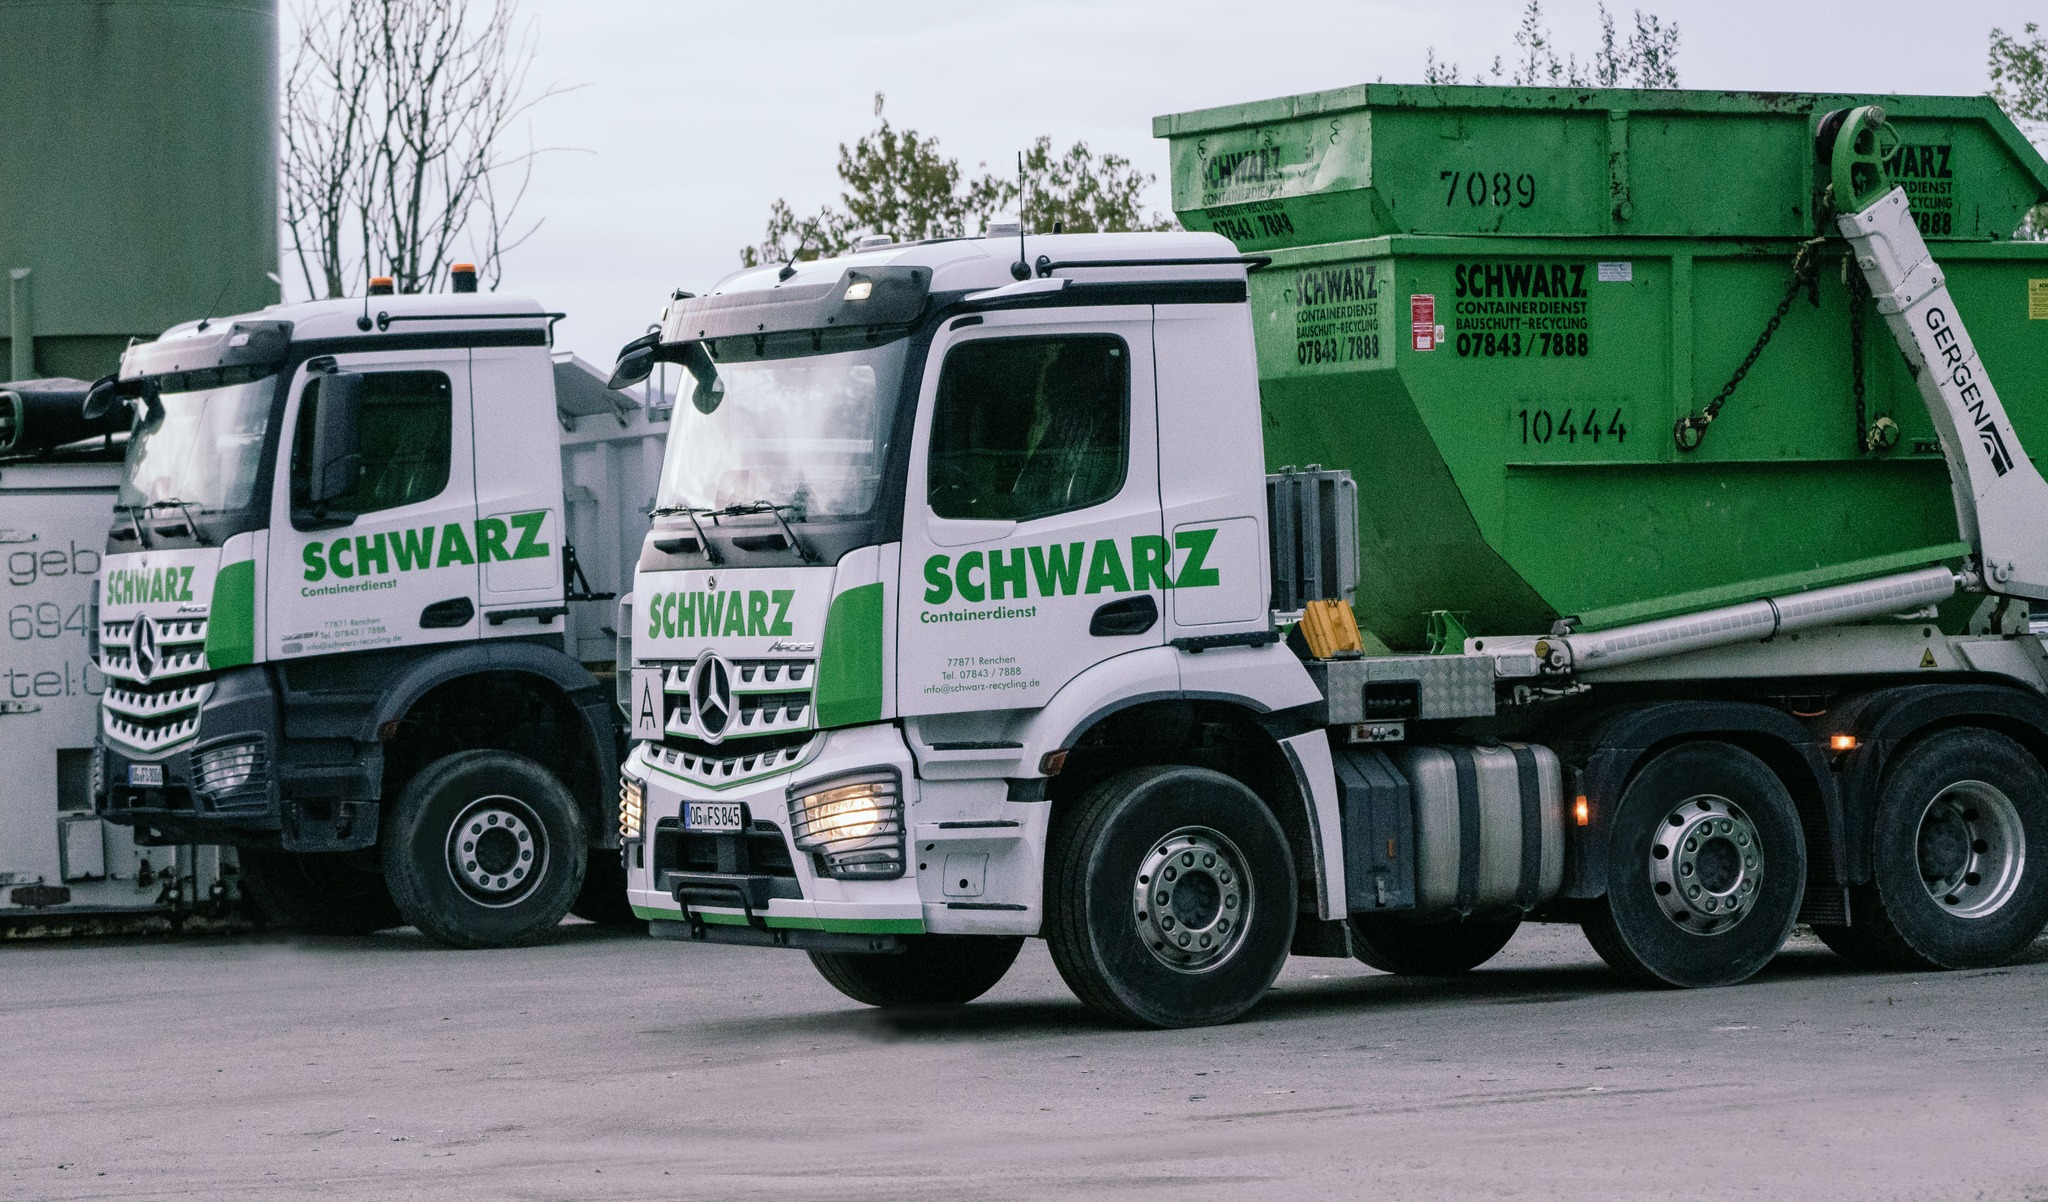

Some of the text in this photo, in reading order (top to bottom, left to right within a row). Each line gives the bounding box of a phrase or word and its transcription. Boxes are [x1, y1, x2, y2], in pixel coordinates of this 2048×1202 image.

[1202, 147, 1282, 190] SCHWARZ
[1440, 171, 1535, 208] 7089
[1258, 212, 1295, 237] 7888
[1296, 265, 1378, 307] SCHWARZ
[1455, 263, 1588, 298] SCHWARZ
[1296, 303, 1378, 323] CONTAINERDIENST
[1456, 301, 1588, 315] CONTAINERDIENST
[1296, 319, 1379, 339] BAUSCHUTT-RECYCLING
[1456, 317, 1588, 330] BAUSCHUTT-RECYCLING
[1298, 338, 1337, 365] 07843
[1348, 334, 1379, 360] 7888
[1456, 332, 1521, 357] 07843
[1539, 332, 1589, 357] 7888
[1926, 307, 1990, 426] GERGEN
[1519, 407, 1627, 444] 10444
[303, 511, 550, 582] SCHWARZ
[924, 529, 1220, 605] SCHWARZ
[106, 566, 195, 606] SCHWARZ
[301, 579, 398, 597] Containerdienst
[648, 589, 796, 639] SCHWARZ
[920, 606, 1037, 624] Containerdienst
[335, 629, 359, 638] 07843
[367, 626, 386, 635] 7888
[942, 671, 957, 680] Tel.
[960, 669, 989, 679] 07843
[999, 667, 1022, 676] 7888
[947, 655, 1016, 667] 77871 Renchen
[923, 678, 1040, 694] info@schwarz-recycling.de
[639, 677, 656, 729] A
[690, 806, 740, 826] OG FS 845
